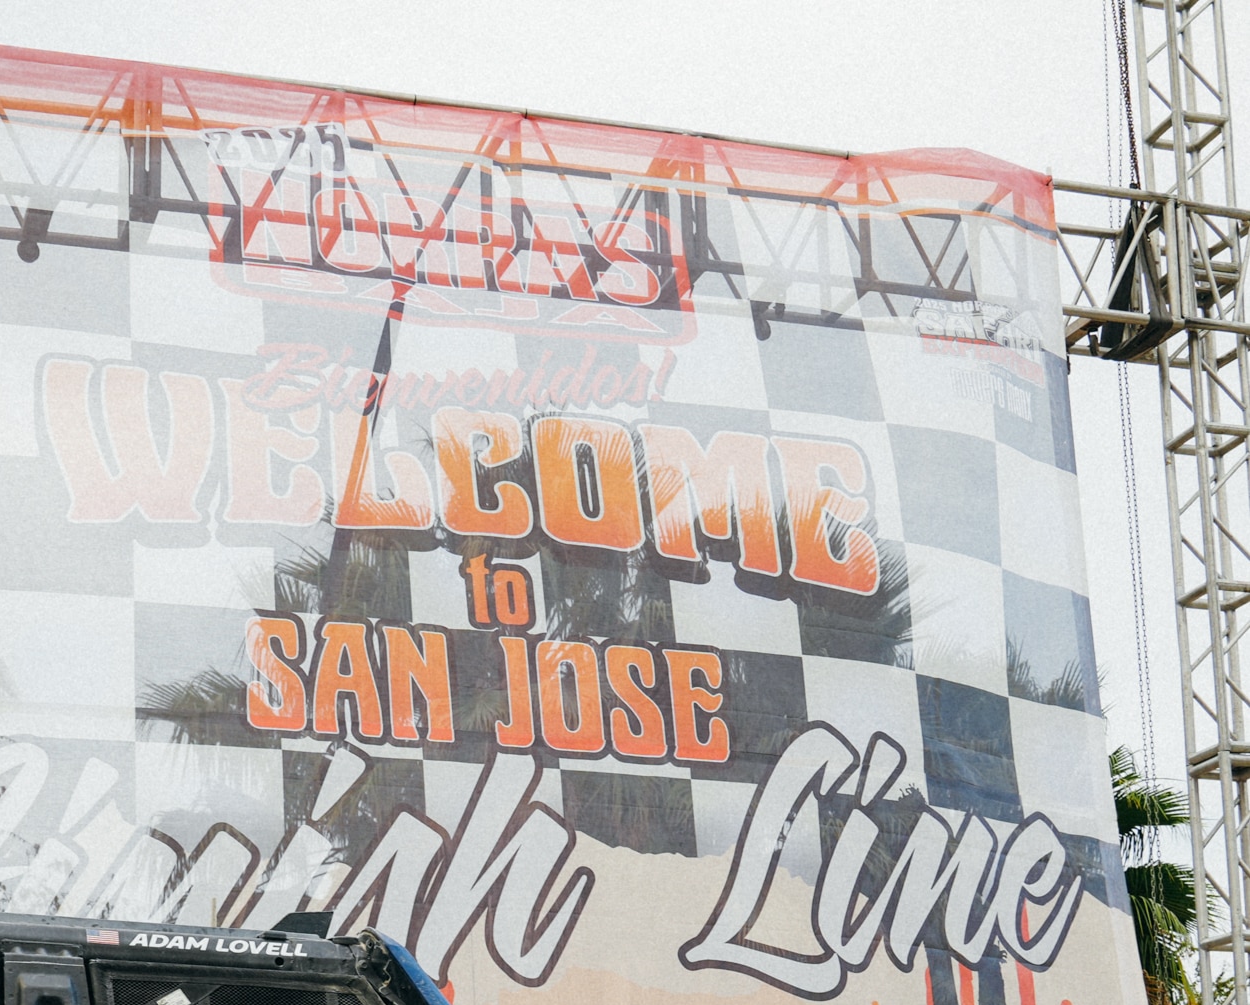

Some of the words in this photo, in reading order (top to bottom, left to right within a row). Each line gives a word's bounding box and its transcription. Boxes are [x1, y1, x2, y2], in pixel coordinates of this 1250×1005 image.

[204, 123, 346, 172] 2025
[241, 167, 661, 306] NORRA'S
[242, 261, 667, 334] BAJA
[41, 356, 881, 597] WELCOME
[465, 554, 531, 627] to
[244, 615, 456, 745] SAN
[494, 634, 732, 765] JOSE
[678, 720, 1081, 1000] Line
[129, 933, 209, 952] ADAM
[215, 938, 308, 957] LOVELL
